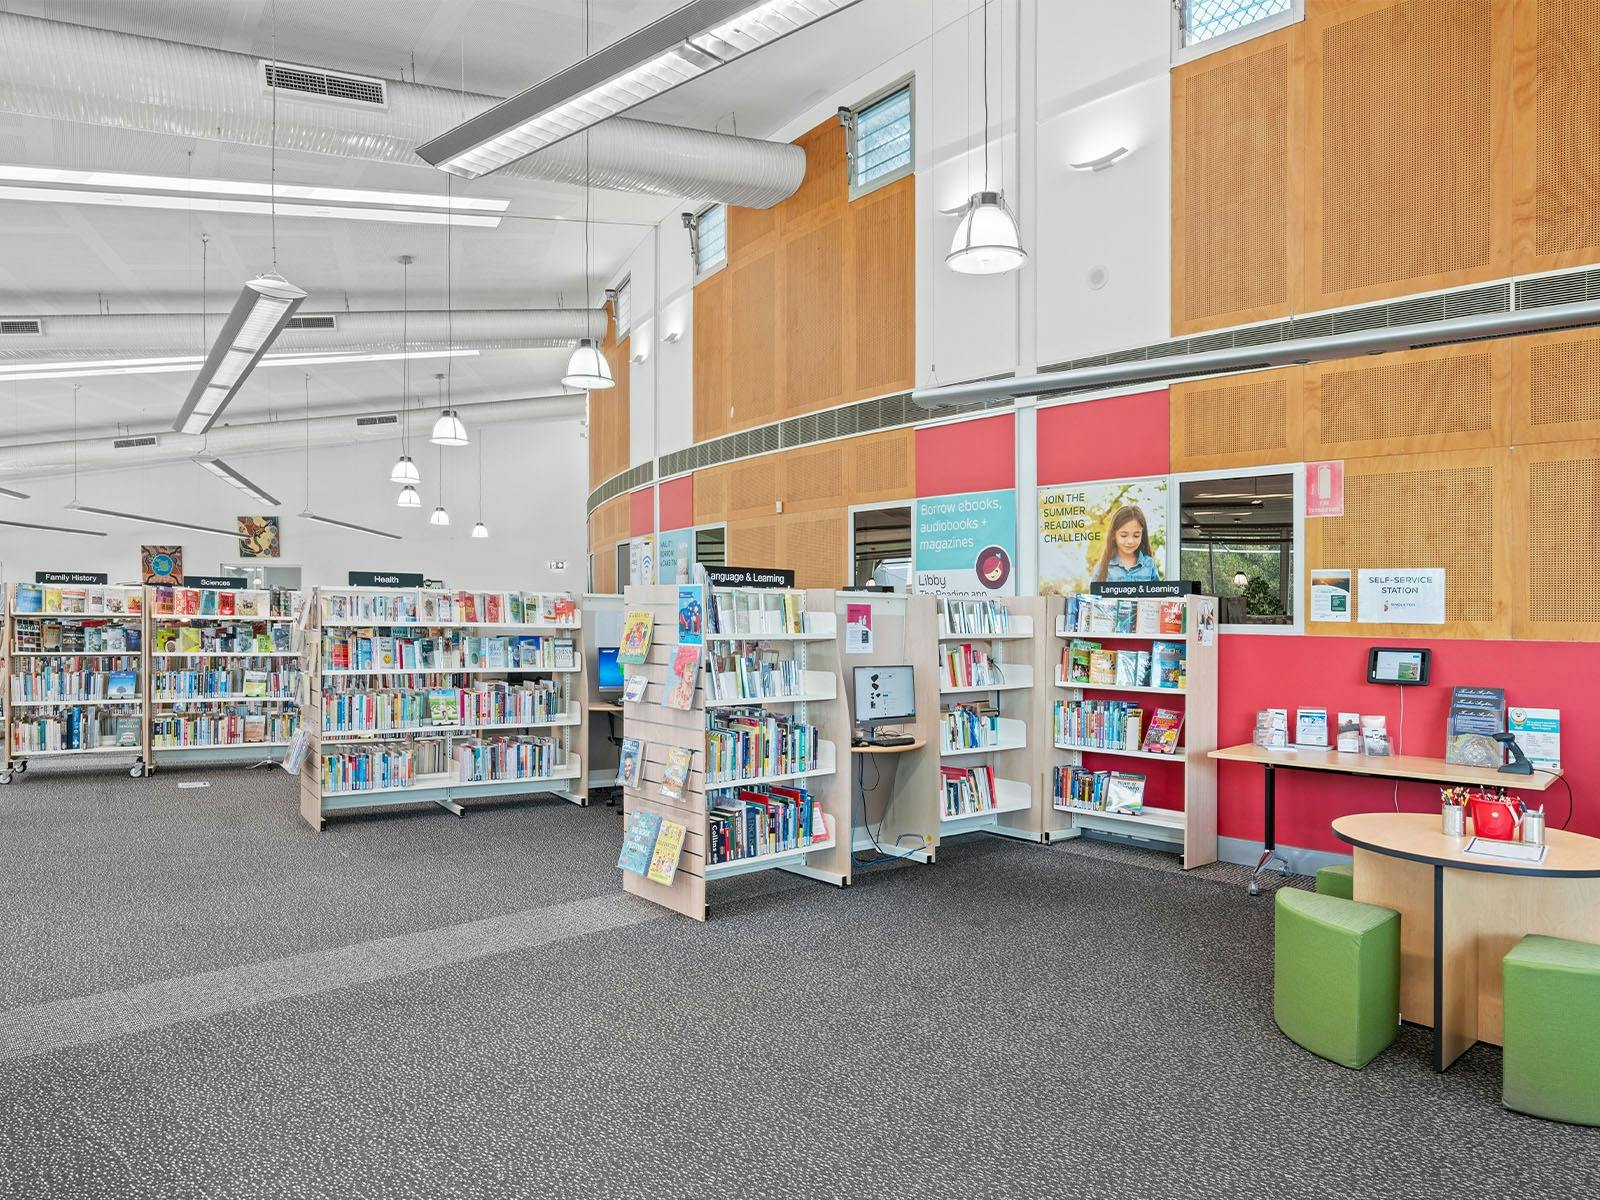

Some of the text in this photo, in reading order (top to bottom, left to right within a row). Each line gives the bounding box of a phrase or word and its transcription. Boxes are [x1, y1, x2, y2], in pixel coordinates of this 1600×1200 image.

[1043, 493, 1085, 505] JOIN THE
[920, 498, 1002, 516] Borrow ebooks,
[1043, 506, 1086, 518] SUMMER
[920, 518, 979, 533] audiobooks
[1044, 519, 1085, 530] READING
[1044, 531, 1101, 543] CHALLENGE
[920, 536, 974, 552] magazines
[45, 573, 97, 582] Family History
[200, 579, 231, 587] Sciences
[374, 575, 399, 584] Health
[710, 571, 785, 584] anguage & Learning
[918, 574, 946, 589] Libby
[1368, 576, 1433, 584] SELF-SERVICE
[1100, 585, 1179, 595] Language & Learning
[1381, 586, 1419, 594] STATION
